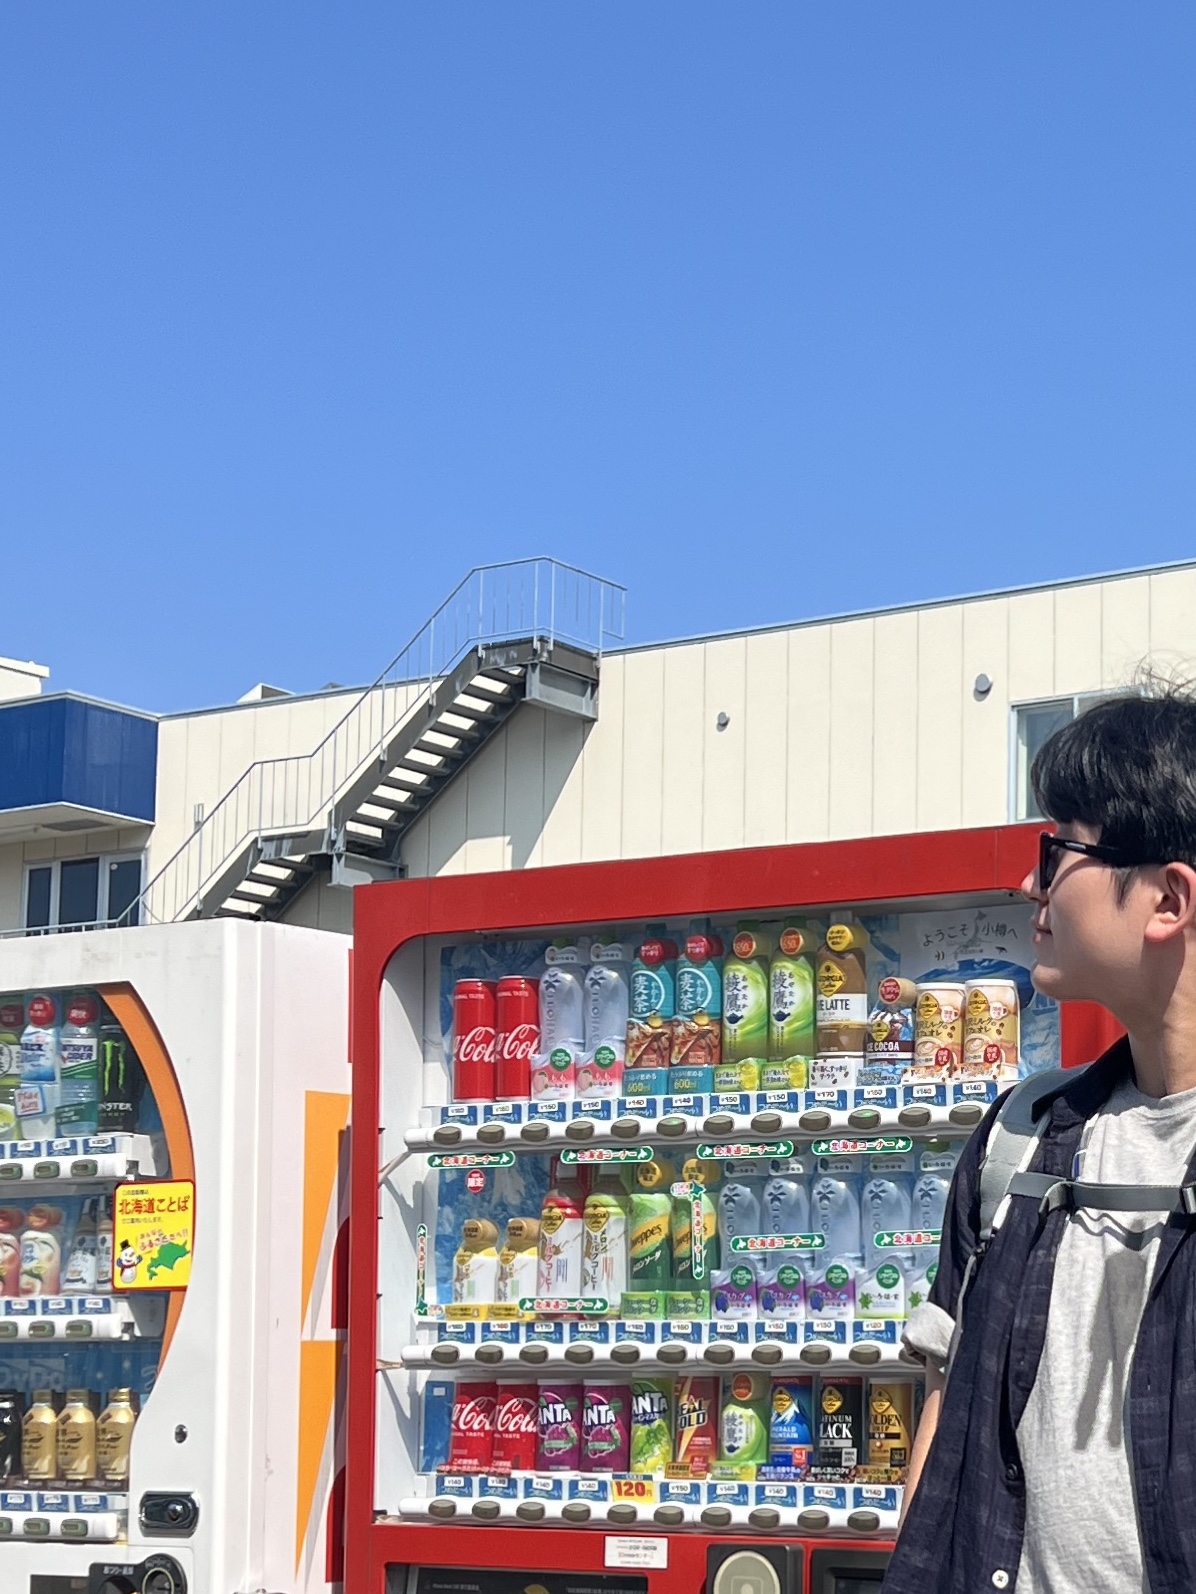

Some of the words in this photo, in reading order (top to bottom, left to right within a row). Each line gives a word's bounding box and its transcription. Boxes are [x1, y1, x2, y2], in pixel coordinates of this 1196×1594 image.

[923, 923, 969, 947] ようこそ
[633, 975, 650, 1013] 麦茶
[679, 972, 696, 1011] 麦茶
[825, 998, 850, 1011] LATTE
[874, 1041, 900, 1052] COCOA
[118, 1194, 191, 1216] 北海道ことば
[892, 1231, 941, 1244] 北海道コー
[632, 1392, 668, 1414] ANTA
[678, 1410, 709, 1430] OLD
[820, 1422, 853, 1439] LACK
